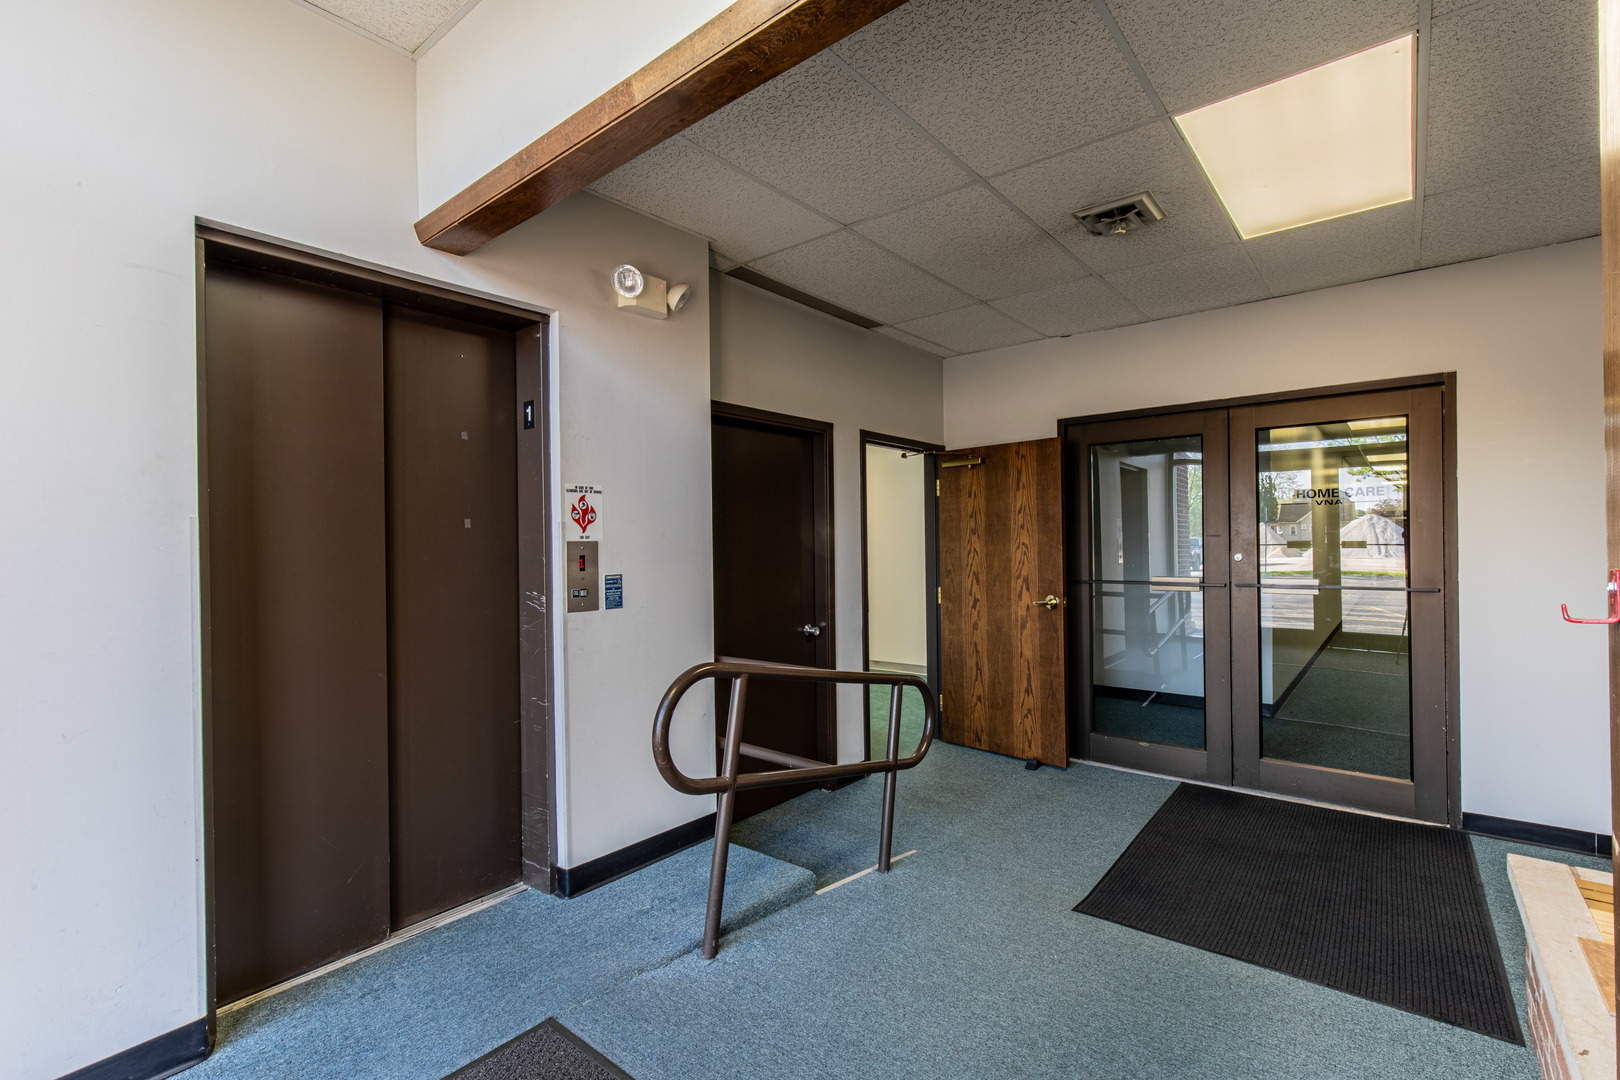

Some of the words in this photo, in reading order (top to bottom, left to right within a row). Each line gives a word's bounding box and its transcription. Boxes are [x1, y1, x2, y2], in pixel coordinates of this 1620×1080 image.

[526, 405, 532, 421] 1
[1345, 486, 1385, 498] CARE
[579, 558, 585, 568] 1
